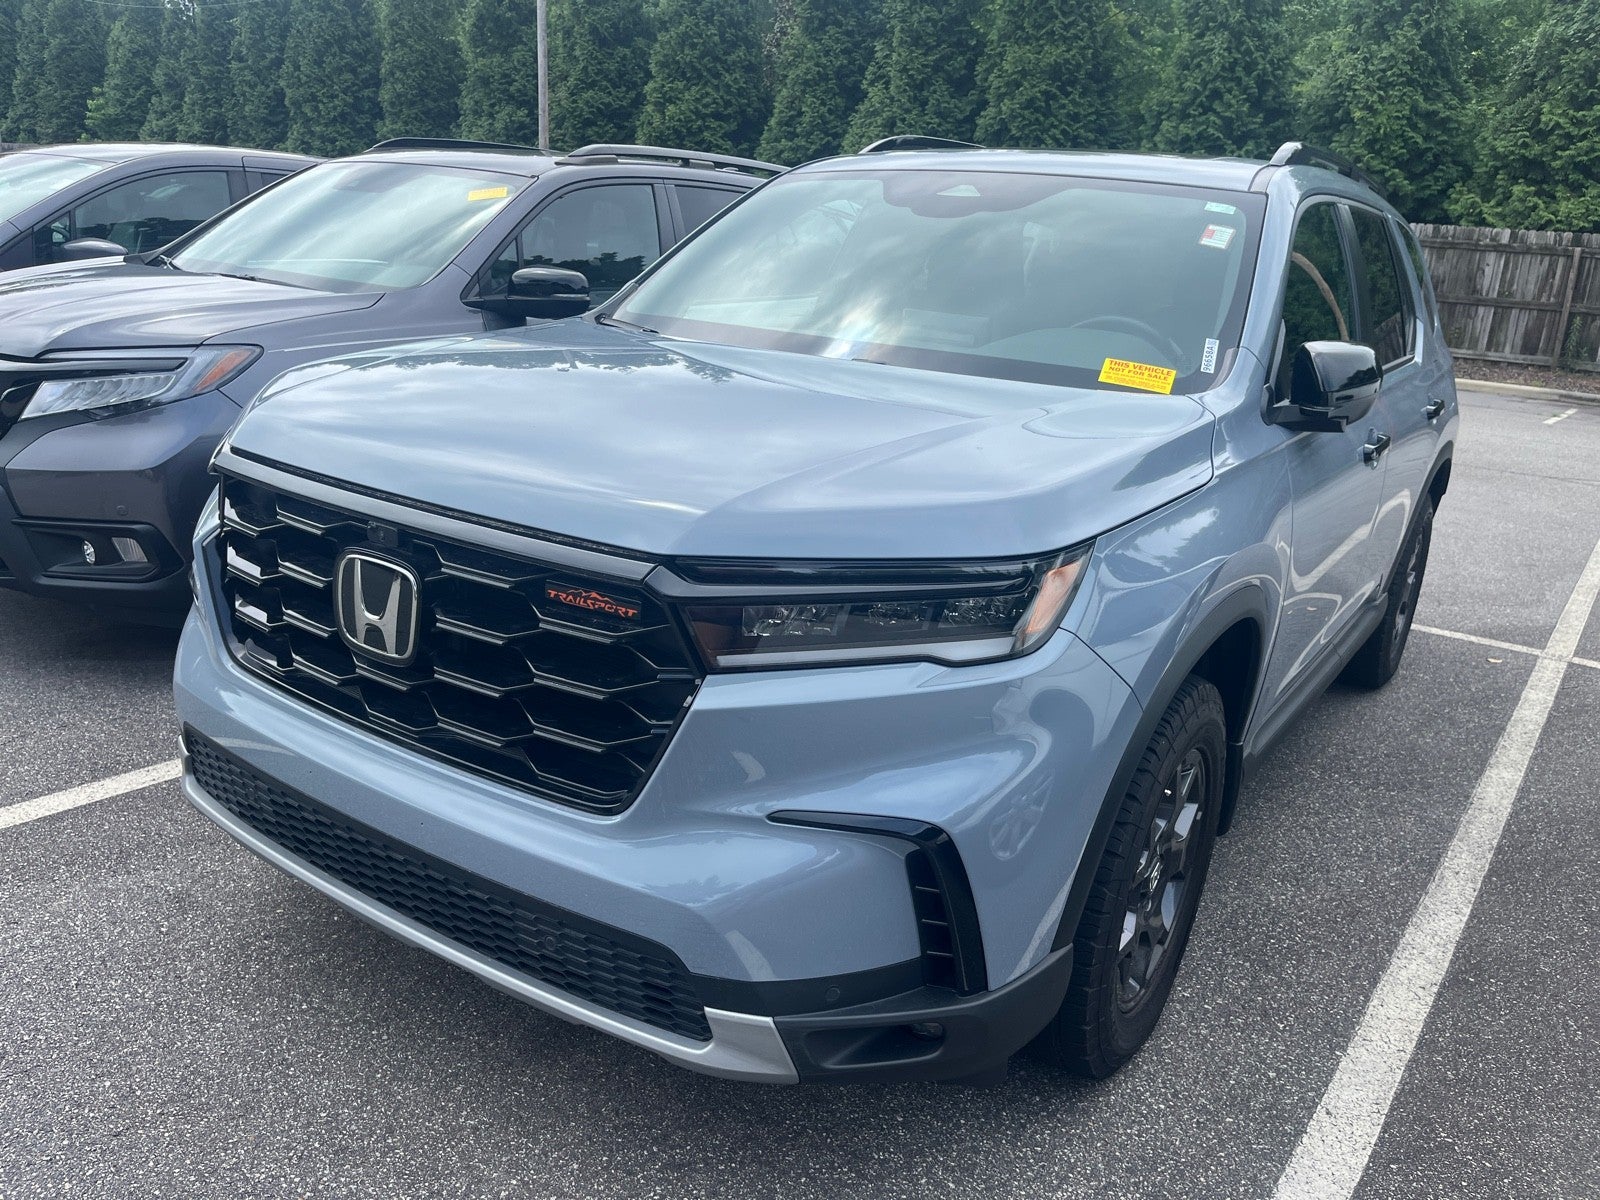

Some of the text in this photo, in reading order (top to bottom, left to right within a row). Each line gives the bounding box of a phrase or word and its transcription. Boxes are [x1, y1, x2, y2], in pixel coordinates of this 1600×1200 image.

[1108, 366, 1126, 374] NOT
[1128, 369, 1146, 377] FOR
[1147, 372, 1169, 382] SALE
[1109, 360, 1173, 377] THIS VEHICLE
[547, 589, 638, 618] TRAILSPORT
